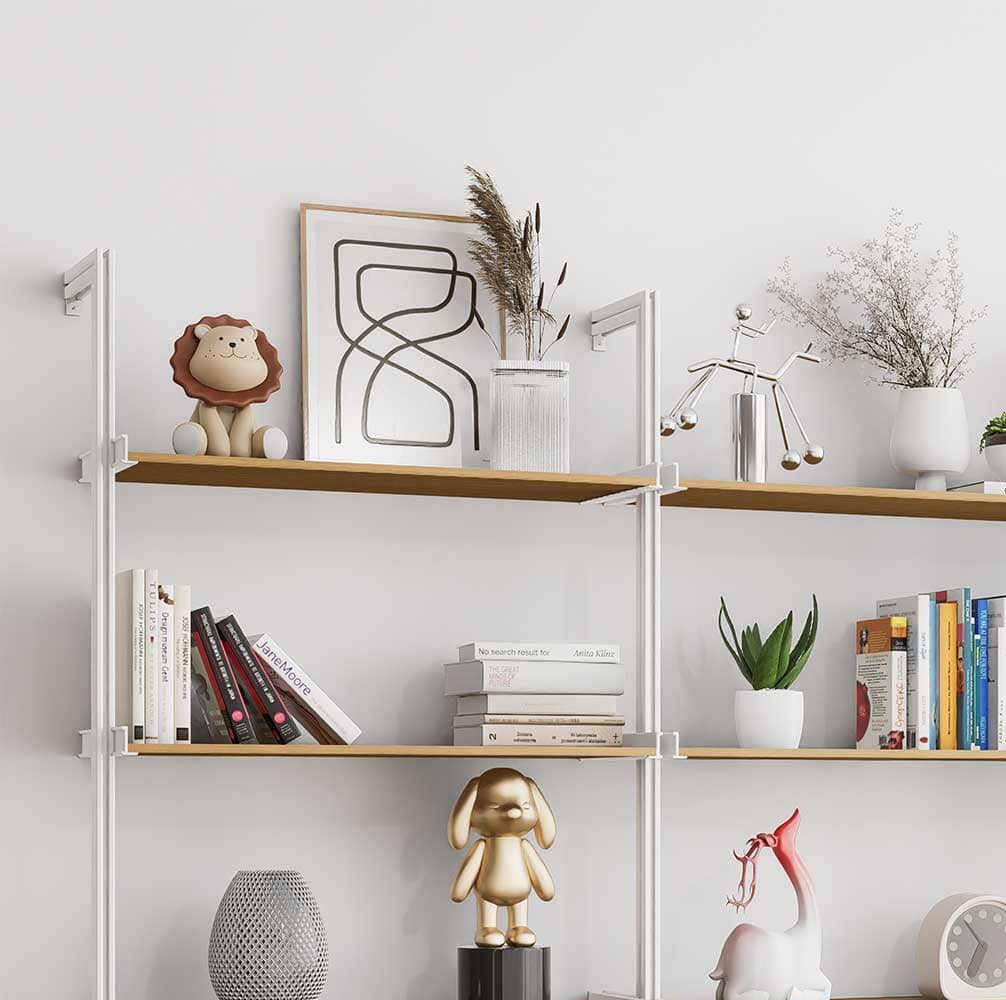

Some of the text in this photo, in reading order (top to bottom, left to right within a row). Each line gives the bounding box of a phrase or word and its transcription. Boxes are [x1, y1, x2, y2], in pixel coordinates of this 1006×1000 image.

[478, 648, 490, 656] No
[517, 648, 539, 656] result
[540, 648, 550, 656] for
[573, 649, 594, 658] Anita
[488, 733, 497, 741] 2
